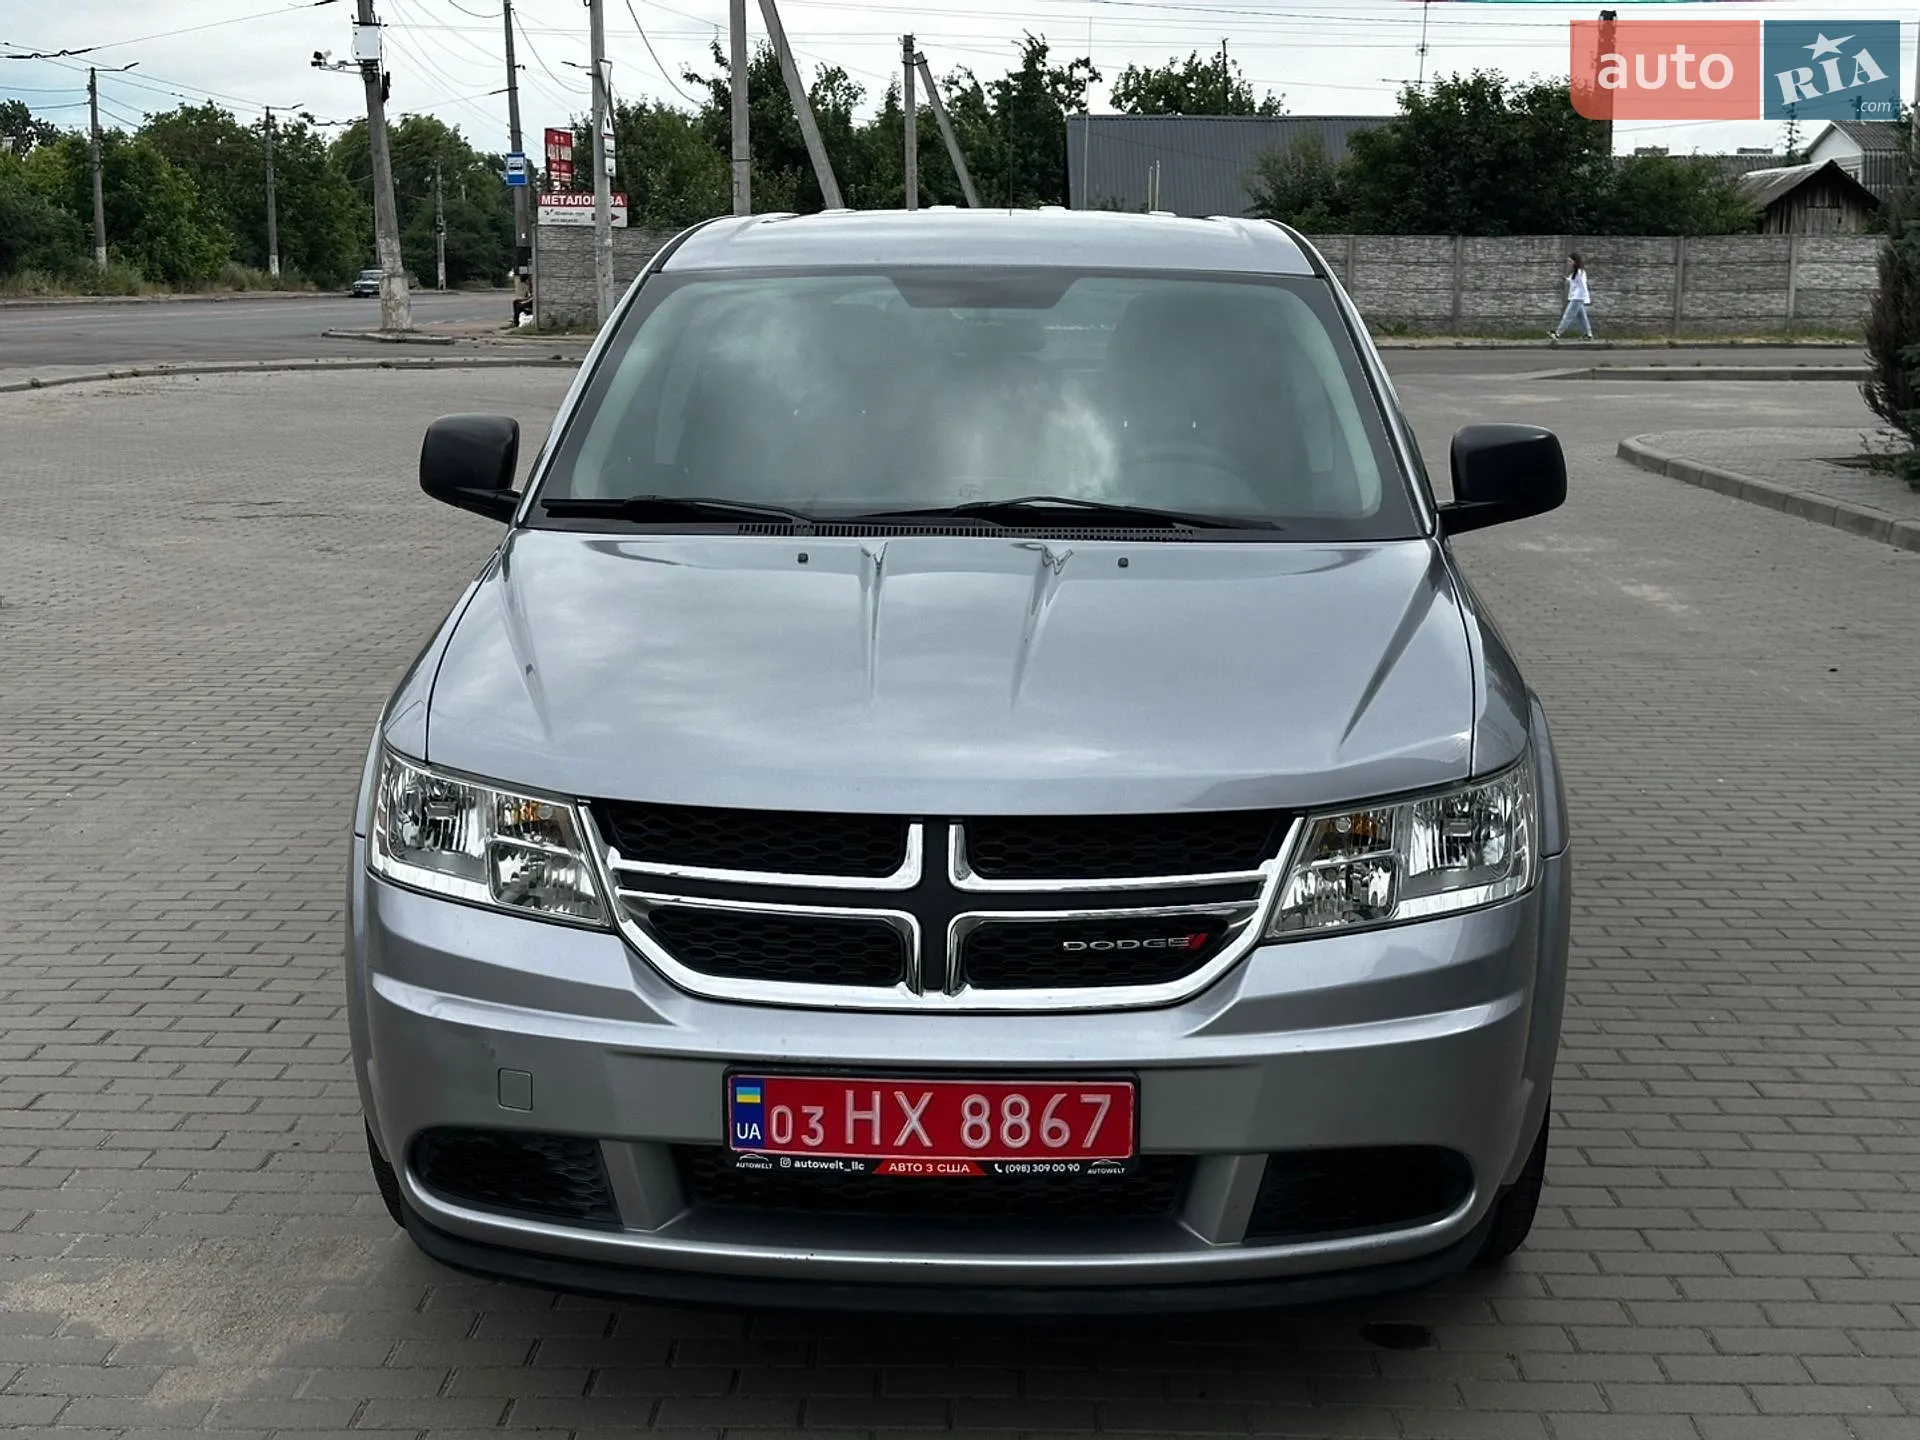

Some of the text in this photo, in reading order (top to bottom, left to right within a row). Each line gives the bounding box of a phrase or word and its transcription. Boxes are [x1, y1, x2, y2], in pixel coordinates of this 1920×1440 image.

[541, 195, 624, 206] МЕТАЛОЗА
[1063, 937, 1190, 951] DODGE
[770, 1089, 1112, 1149] 03 HX 8867
[737, 1122, 761, 1140] UA
[794, 1160, 865, 1171] autowelt_llc
[888, 1163, 923, 1172] АВТО
[937, 1164, 970, 1173] США
[1005, 1163, 1081, 1174] (098) 309 00 90
